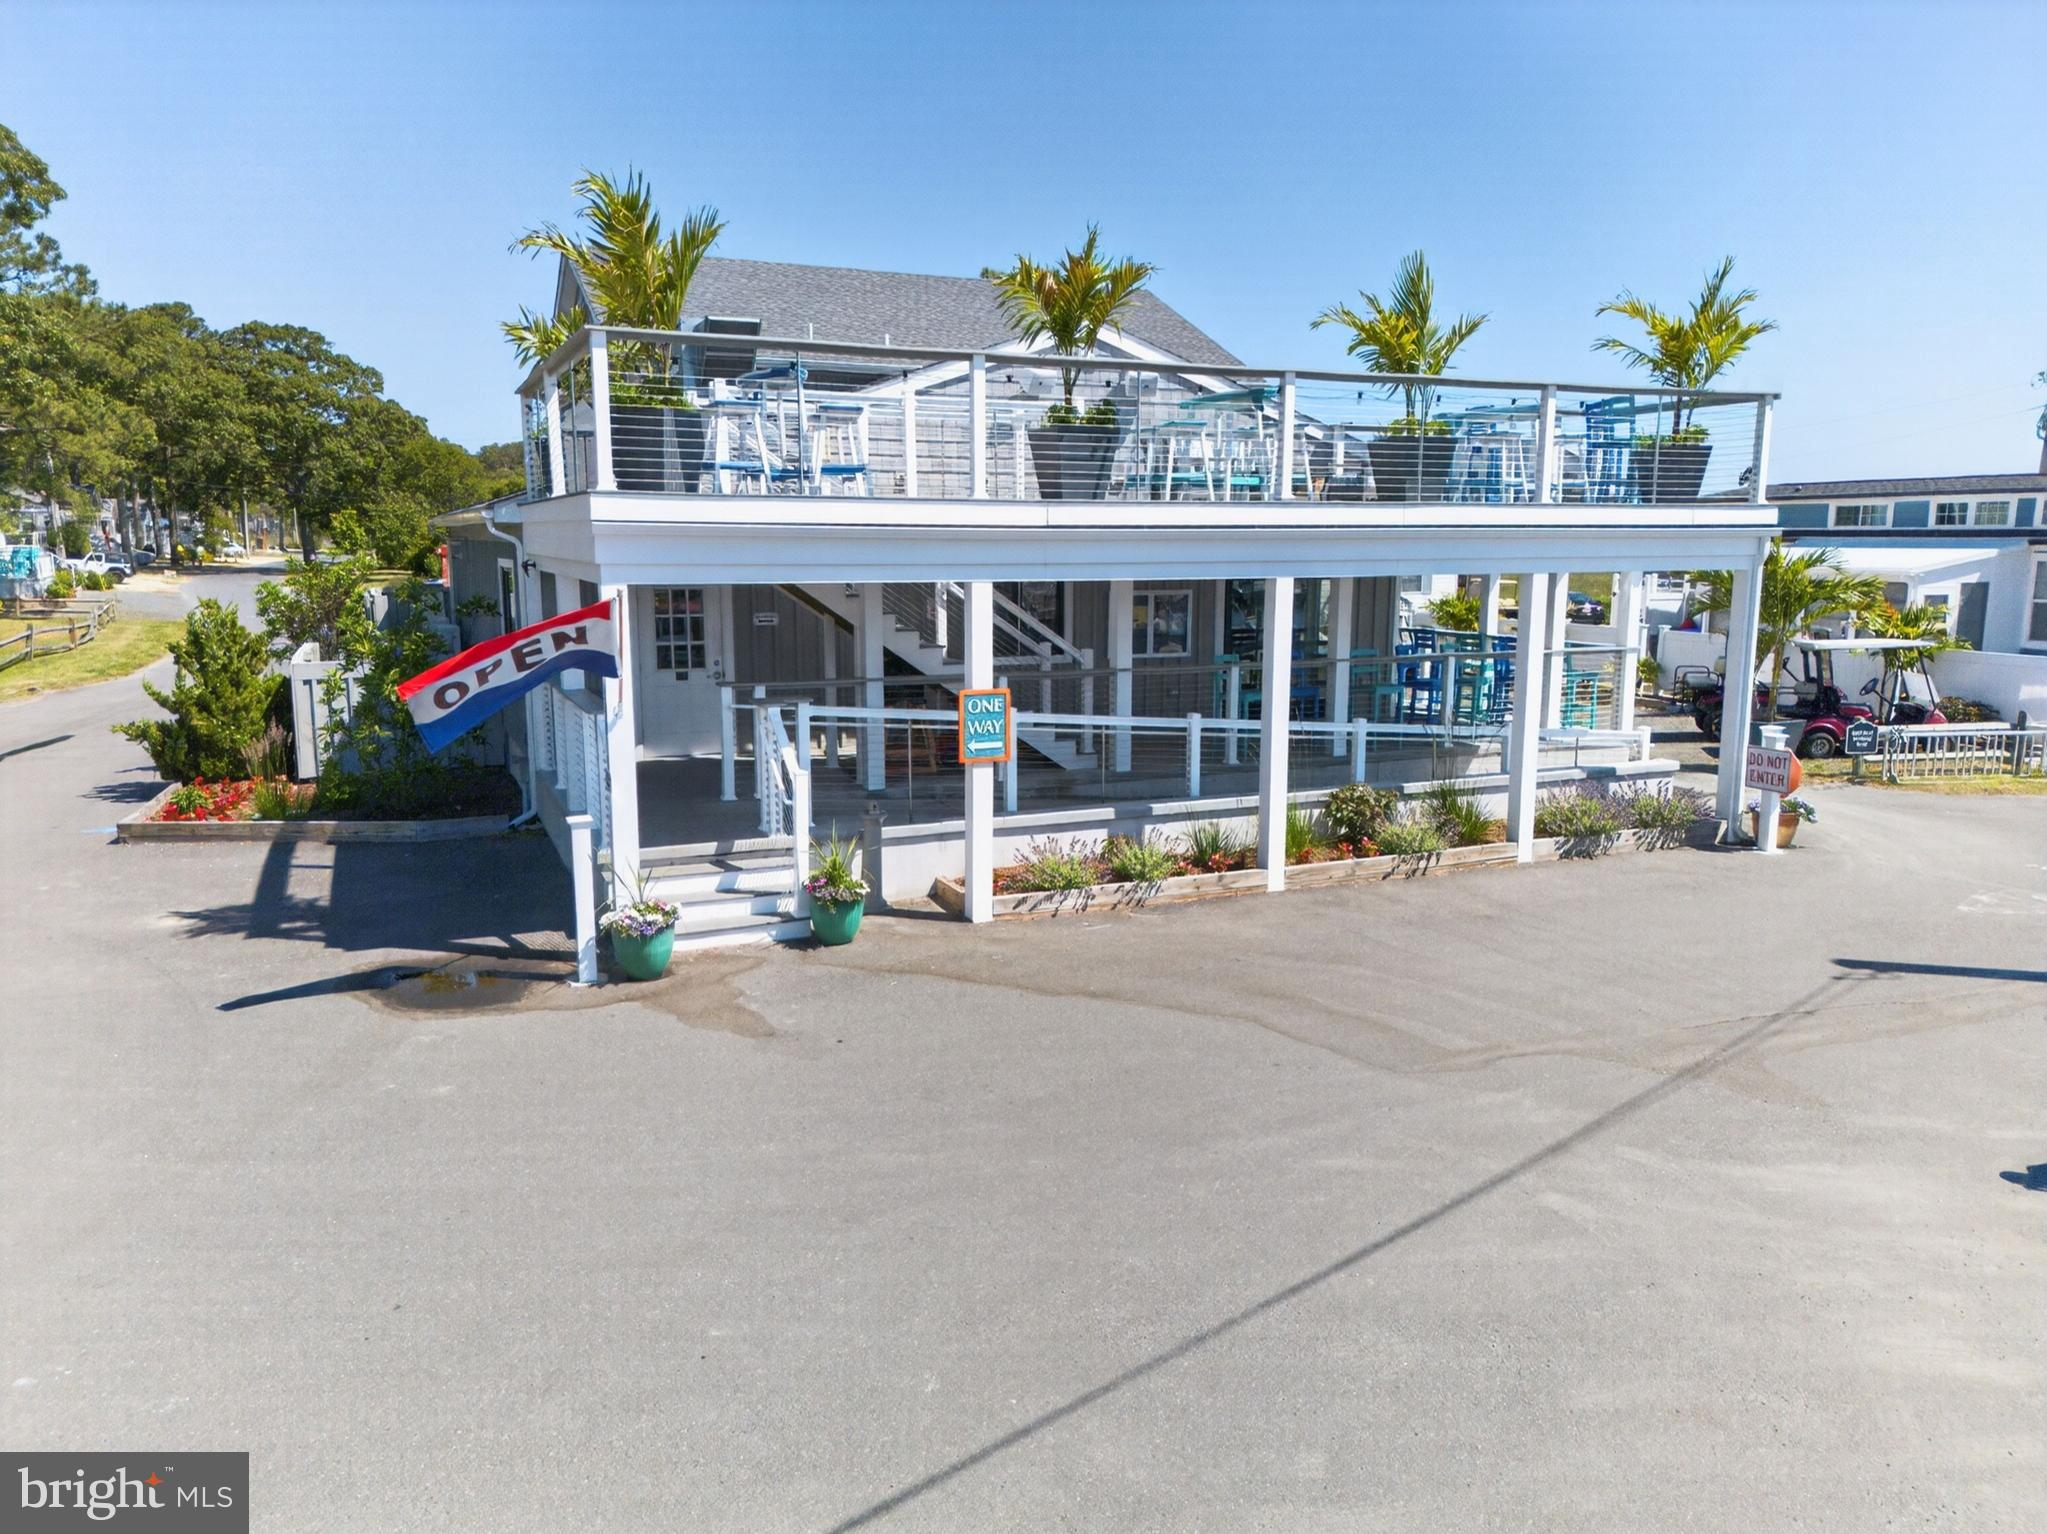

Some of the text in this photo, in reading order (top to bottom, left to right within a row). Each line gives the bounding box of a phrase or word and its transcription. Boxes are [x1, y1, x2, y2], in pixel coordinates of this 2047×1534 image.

[433, 625, 589, 710] OPEN
[967, 698, 1004, 714] ONE
[967, 719, 1004, 736] WAY
[1749, 752, 1788, 770] DO NOT
[1749, 769, 1785, 787] ENTER
